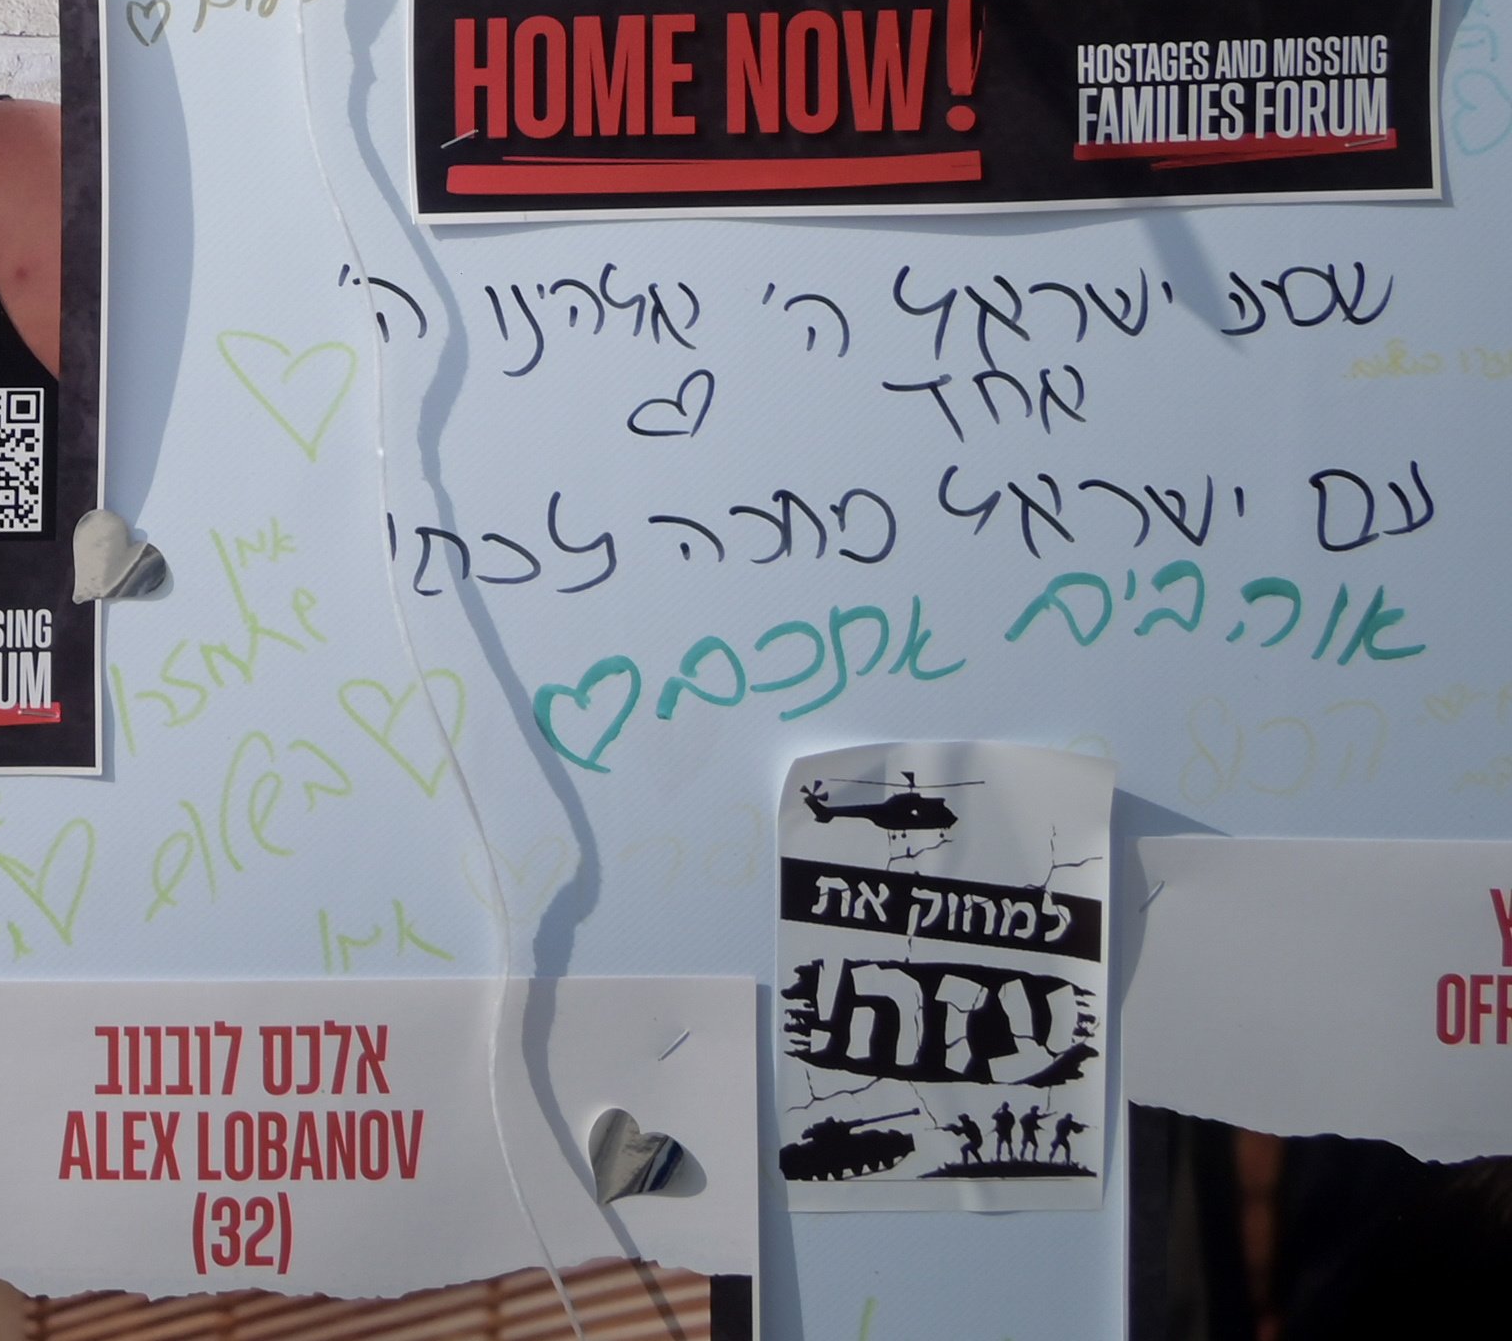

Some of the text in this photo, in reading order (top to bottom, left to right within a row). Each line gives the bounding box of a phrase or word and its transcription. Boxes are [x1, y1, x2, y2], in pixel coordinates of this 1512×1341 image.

[1078, 35, 1387, 84] HOSTAGES AND MISSING
[1079, 78, 1387, 145] FAMILIES FORUM
[882, 364, 1088, 443] אחד
[656, 559, 1427, 721] אוהבים אתכם
[810, 875, 1072, 943] למחוק את
[97, 1021, 389, 1096] אלכס לובנוב
[61, 1111, 424, 1181] ALEX LOBANOV
[195, 1193, 293, 1274] (32)
